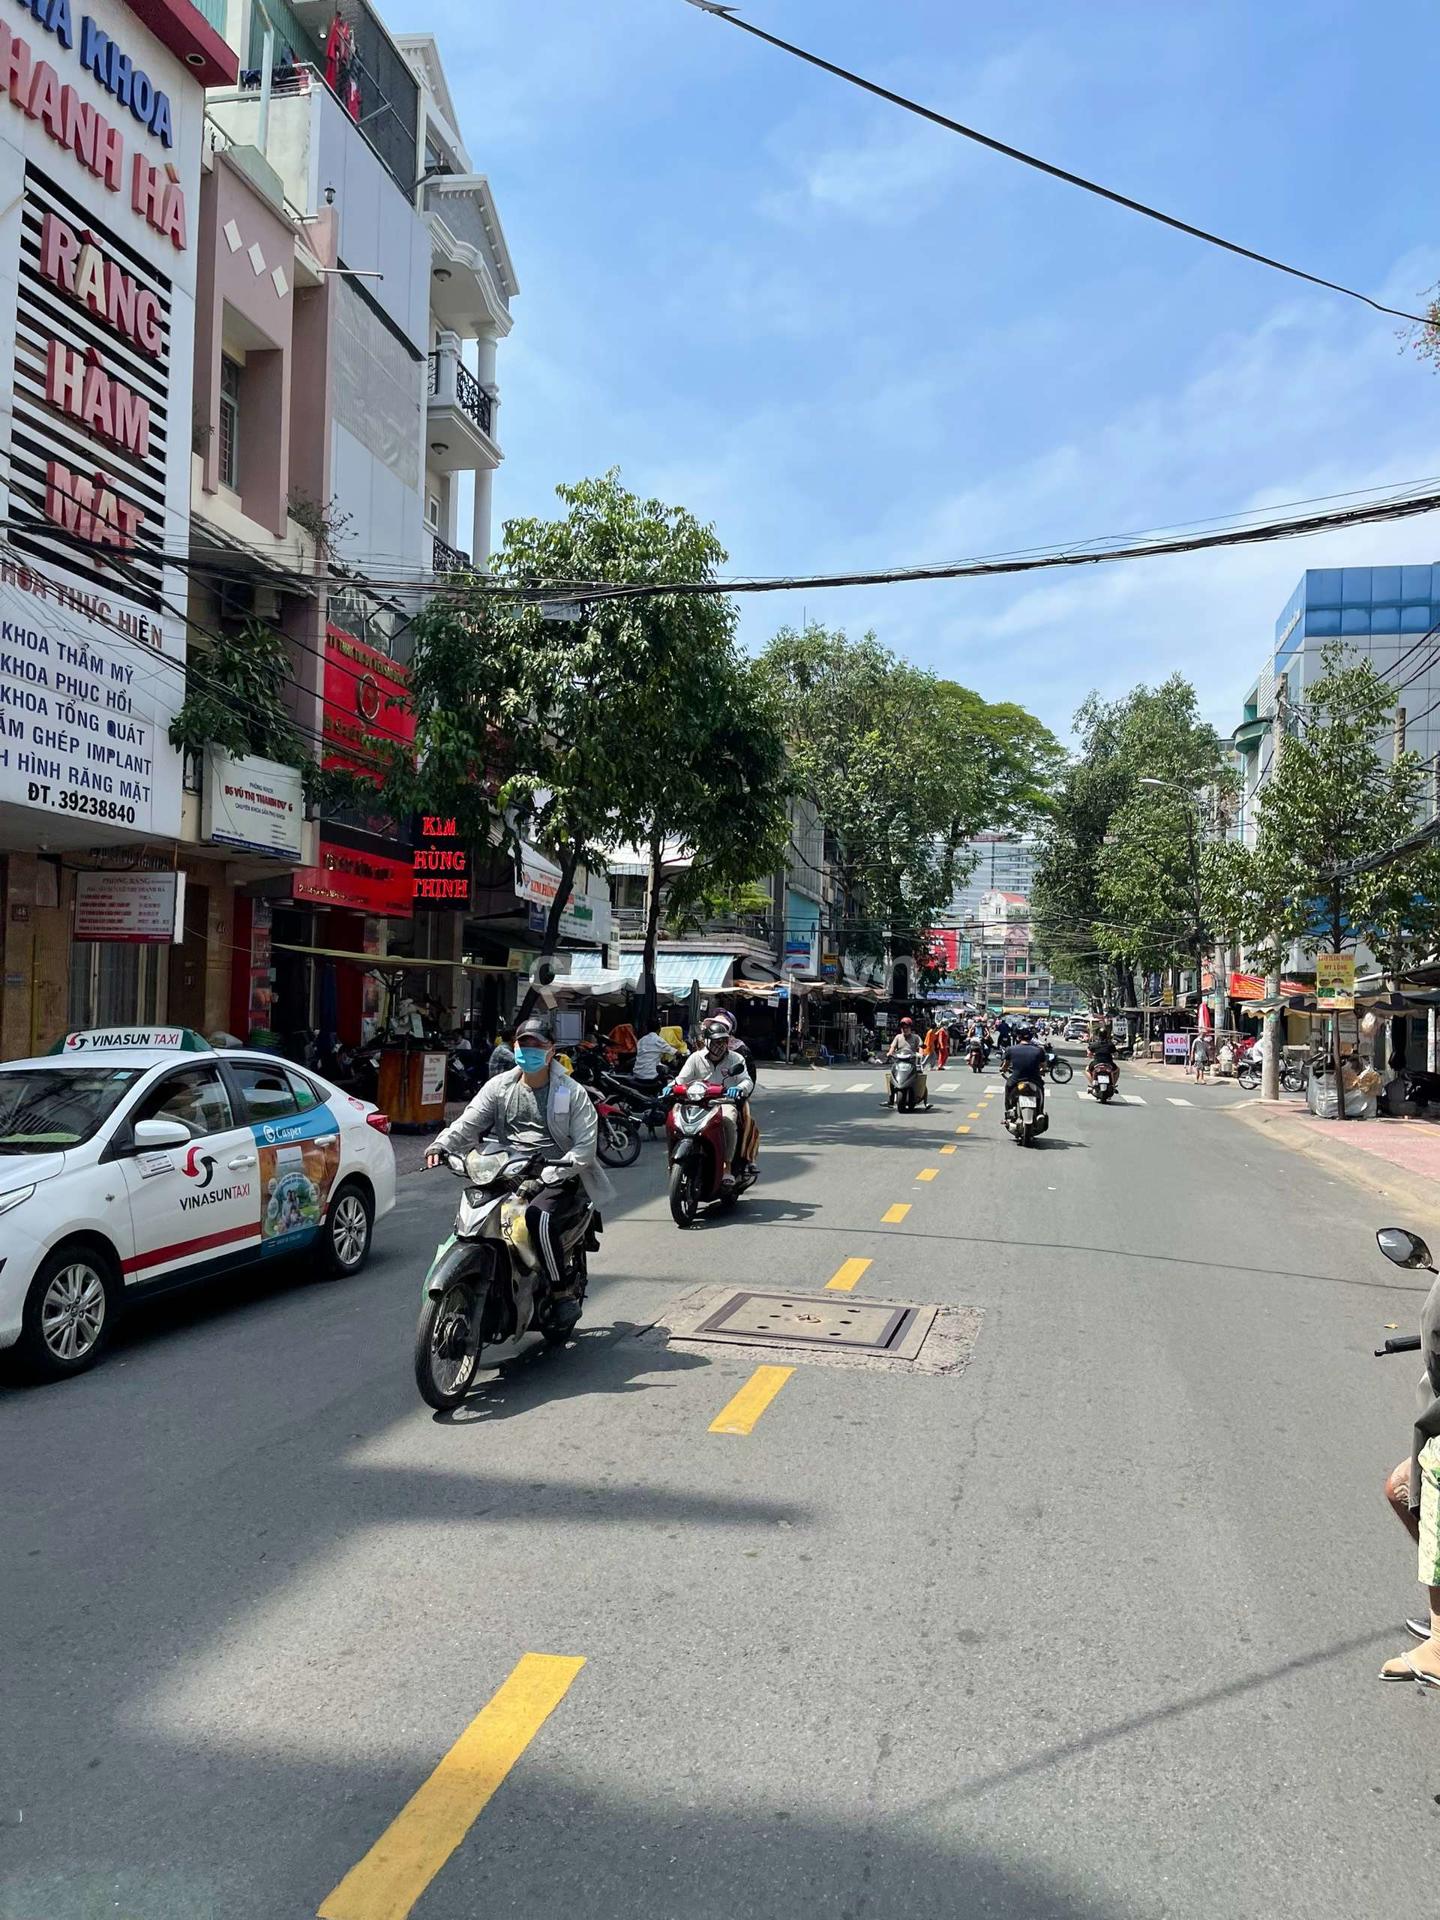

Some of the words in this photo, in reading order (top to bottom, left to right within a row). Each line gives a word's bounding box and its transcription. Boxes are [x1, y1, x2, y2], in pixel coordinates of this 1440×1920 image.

[80, 15, 173, 149] KHOA
[131, 153, 188, 251] HÀ
[45, 338, 150, 458] HÀM
[2, 621, 49, 655] KHOA
[57, 643, 104, 676] THẨM
[111, 664, 134, 685] MỸ
[1, 653, 48, 685] KHOA
[56, 672, 99, 703] PHỤC
[107, 689, 132, 714] HỒI
[1, 684, 48, 716] KHOA
[55, 699, 99, 732] TỔNG
[107, 719, 145, 746] QUÁT
[18, 752, 60, 780] HÌNH
[69, 766, 113, 793] RĂNG
[120, 780, 150, 804] MẶT
[33, 726, 80, 754] GHÉP
[87, 742, 152, 776] IMPLANT
[423, 816, 458, 836] KIM
[413, 845, 466, 870] HÙNG
[92, 1033, 151, 1047] VINASUN
[154, 1033, 179, 1045] TAXI
[276, 1126, 302, 1140] Casper
